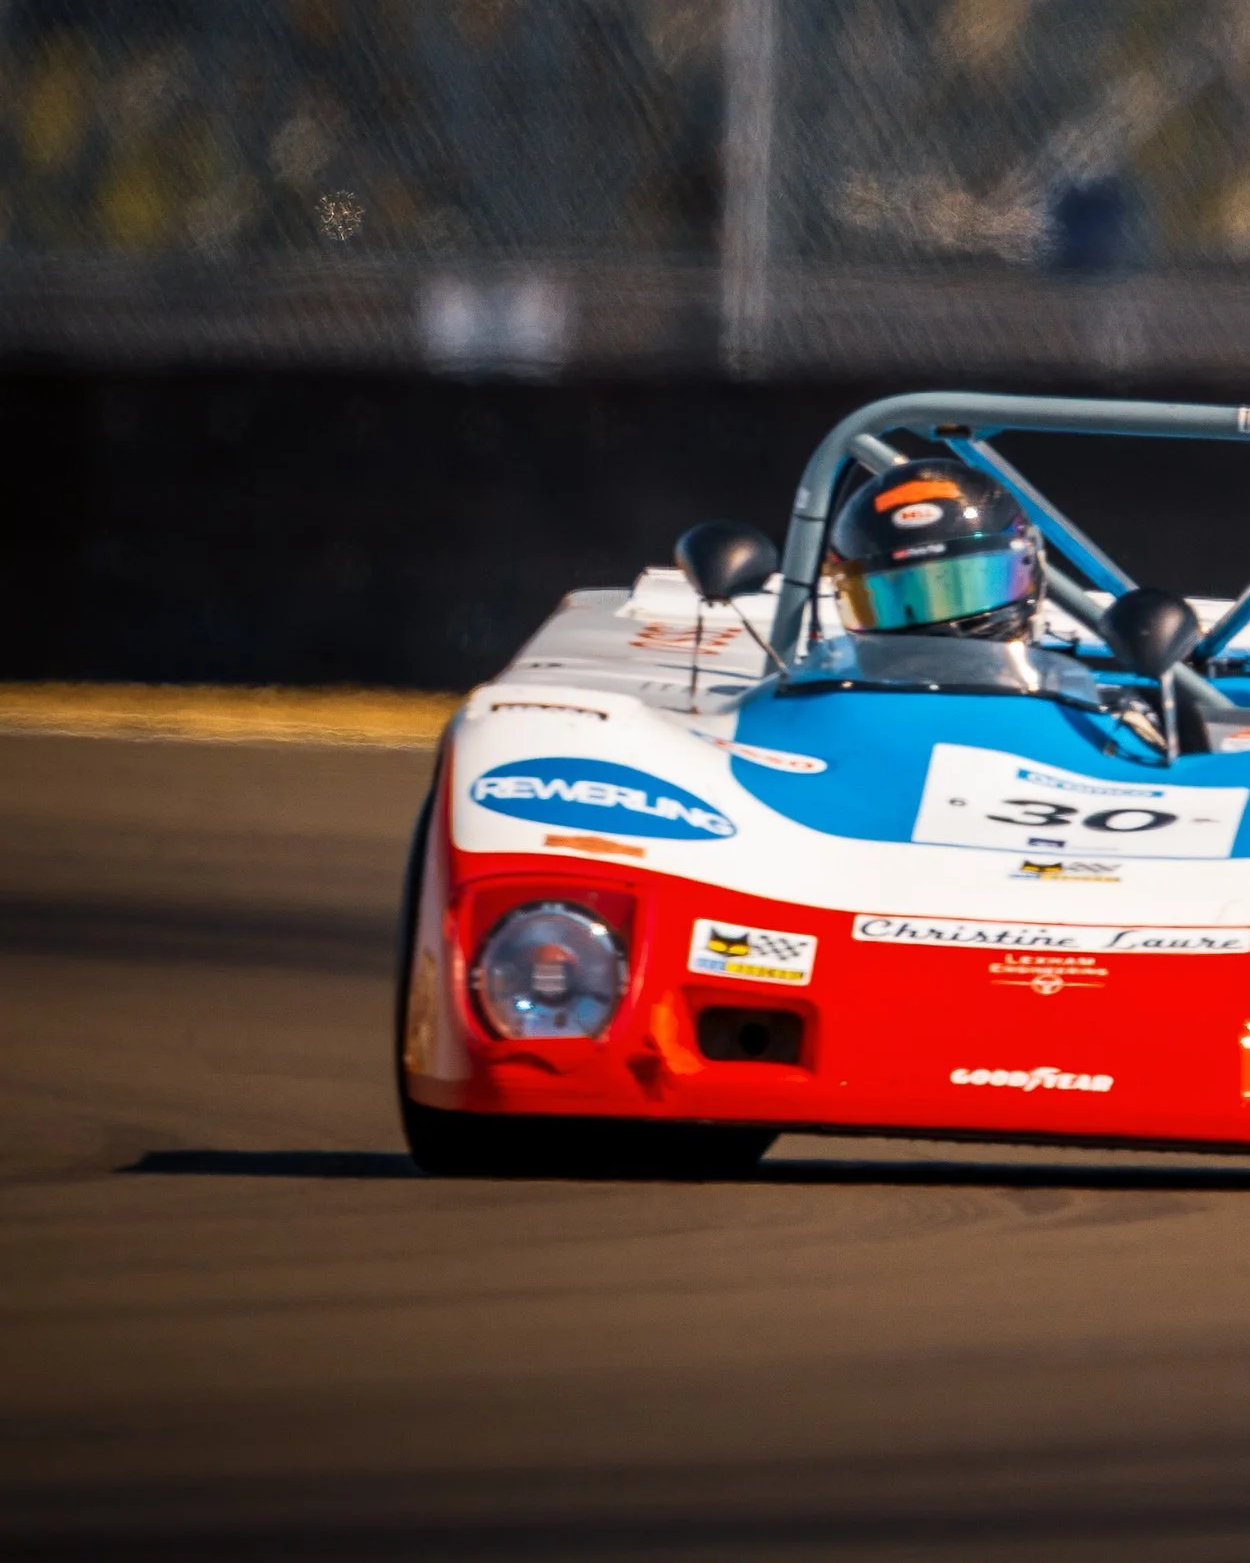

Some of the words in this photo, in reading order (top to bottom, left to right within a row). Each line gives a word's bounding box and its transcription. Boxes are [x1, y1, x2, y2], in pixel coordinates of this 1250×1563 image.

[473, 776, 737, 837] REWERLING
[984, 798, 1179, 832] 30
[860, 918, 1081, 950] Christine
[1104, 928, 1245, 951] Laure
[950, 1066, 1114, 1093] GOODYEAR
